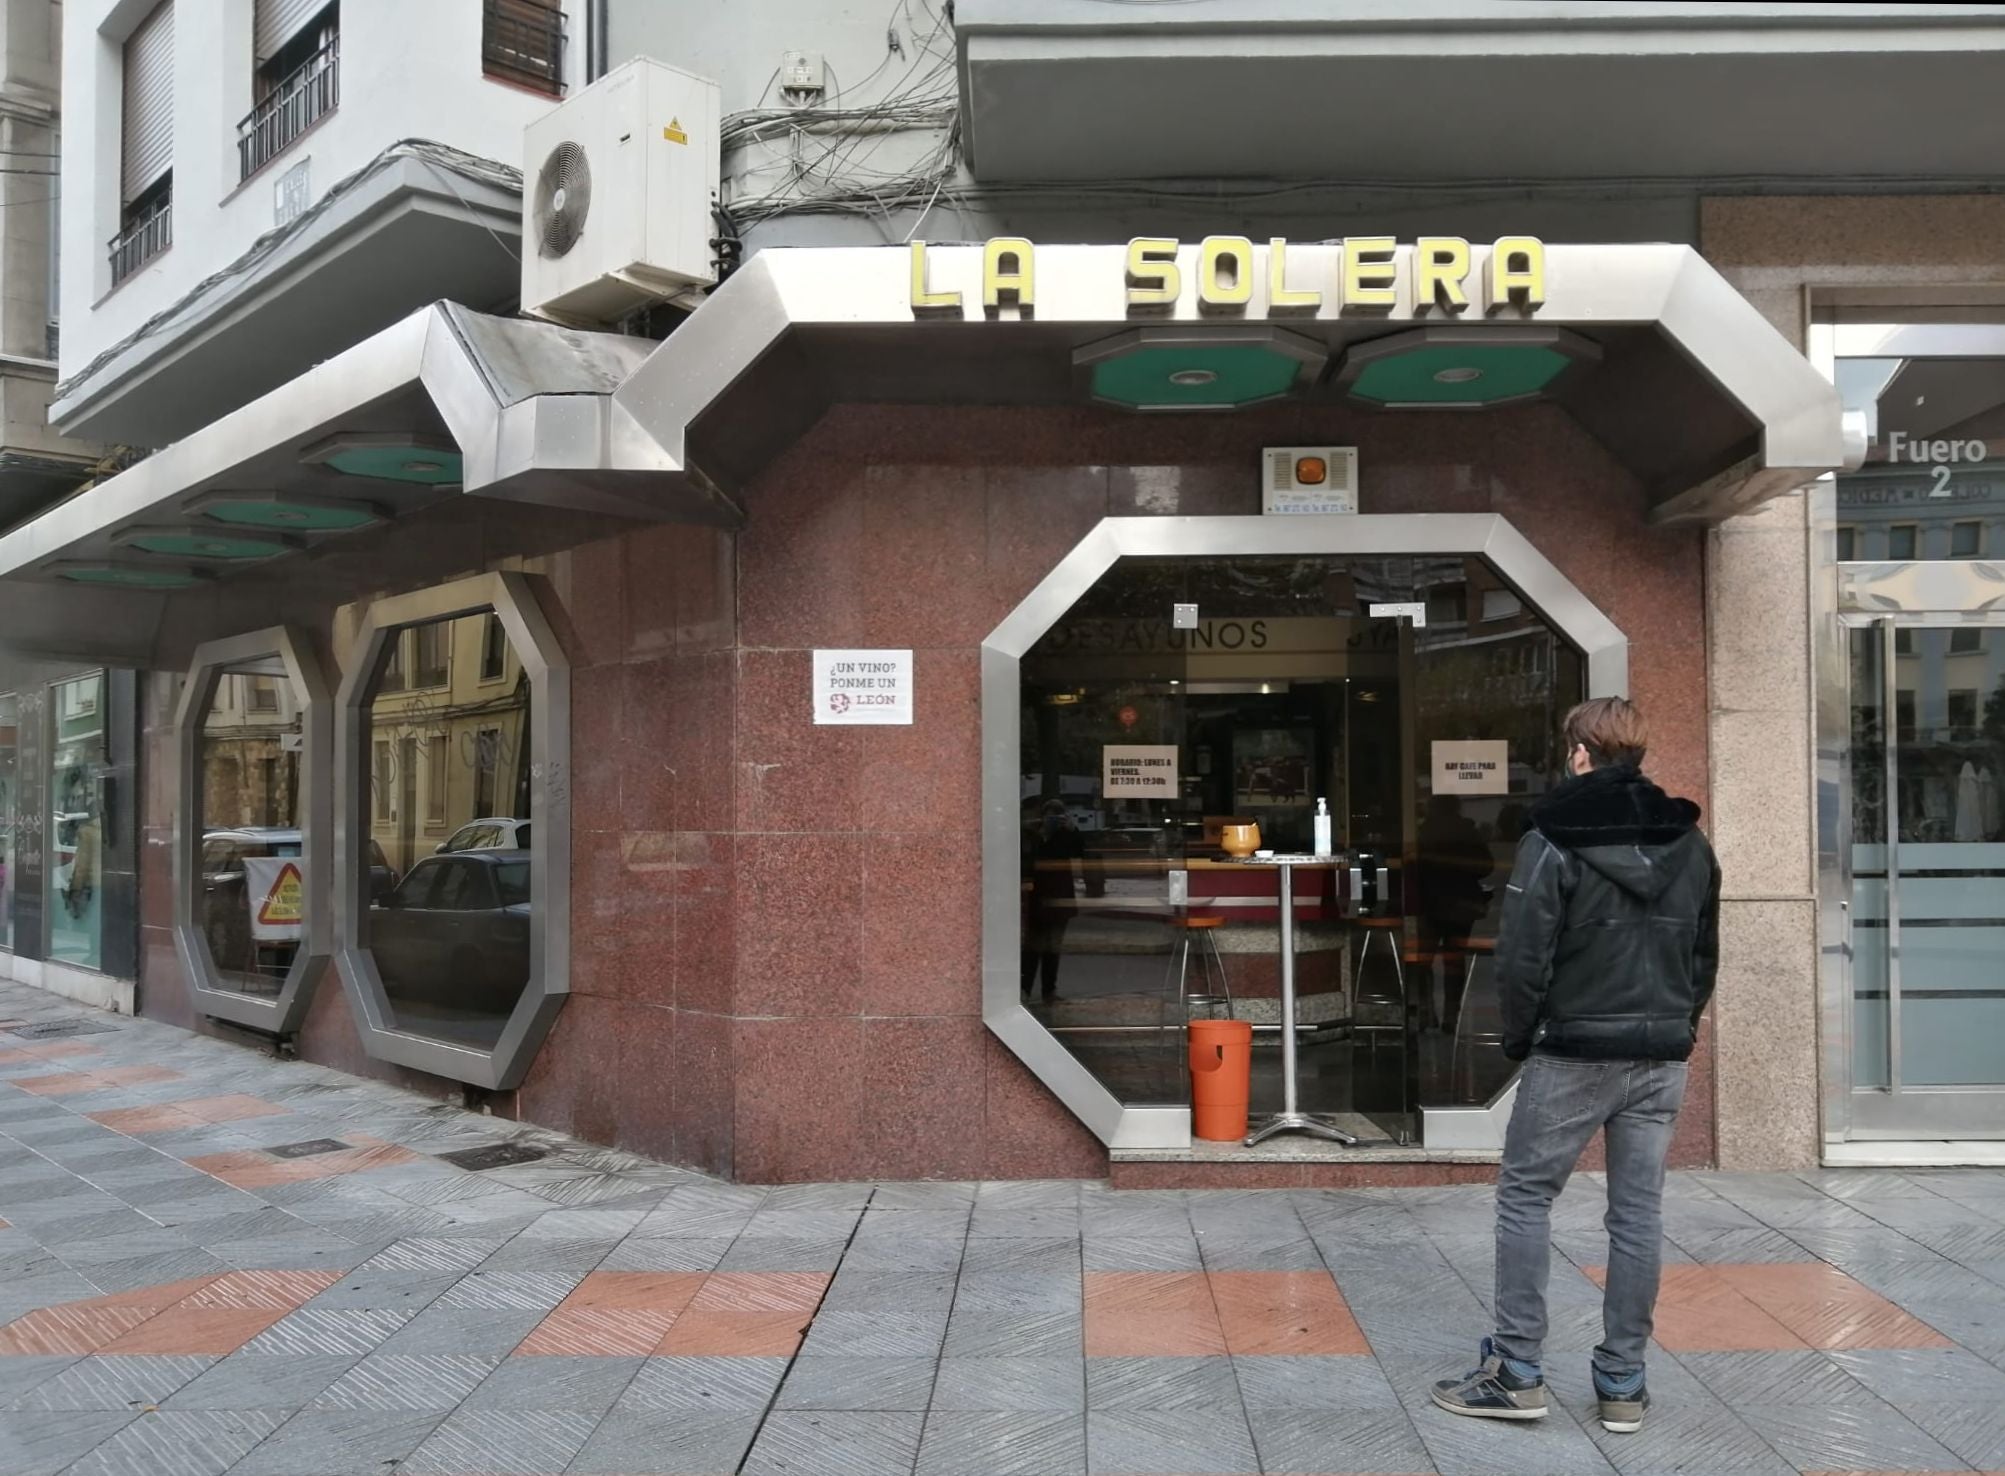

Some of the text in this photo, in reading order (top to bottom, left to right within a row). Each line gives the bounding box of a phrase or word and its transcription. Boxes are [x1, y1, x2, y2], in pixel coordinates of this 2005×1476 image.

[911, 236, 1545, 312] LA SOLERA
[1888, 431, 1987, 463] Fuero
[1928, 465, 1953, 498] 2
[1049, 620, 1268, 649] DESAYUNOS
[858, 662, 897, 673] VINO?
[830, 678, 897, 688] PONME UN
